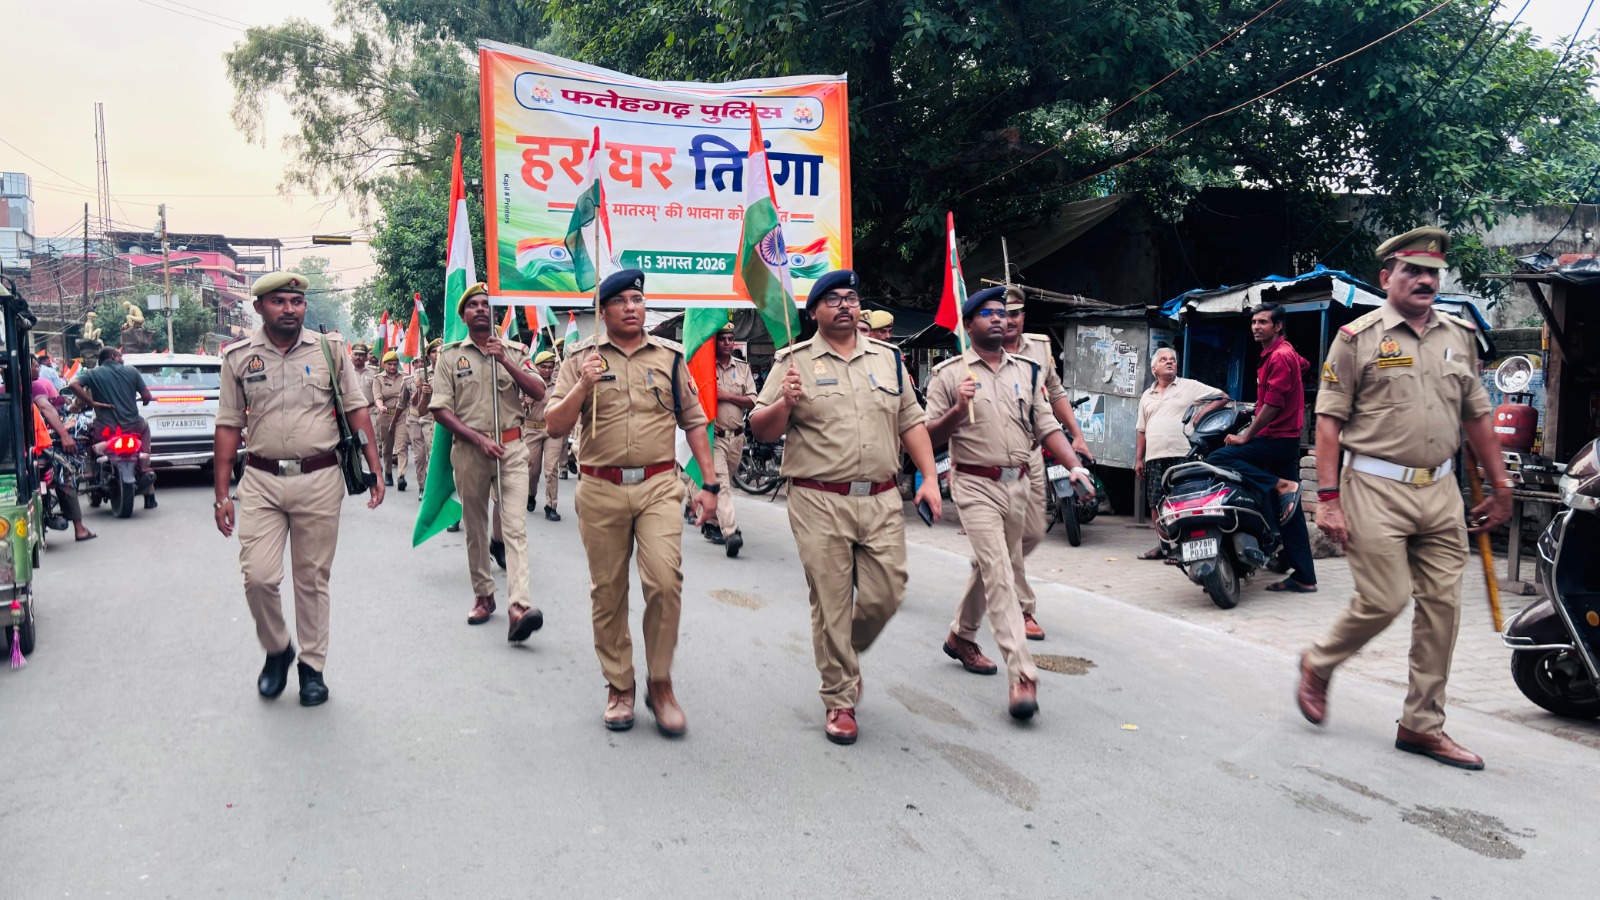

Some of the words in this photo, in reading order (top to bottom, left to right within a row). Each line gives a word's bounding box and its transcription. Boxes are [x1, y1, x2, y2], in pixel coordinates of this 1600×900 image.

[560, 89, 694, 119] फतेहगढ़
[700, 101, 783, 124] पुलिस
[516, 135, 589, 192] हर
[605, 142, 677, 190] घर
[688, 134, 823, 196] तिंगा
[502, 173, 510, 190] Kapil
[665, 202, 683, 218] की
[687, 206, 724, 220] भावना
[728, 205, 745, 221] को
[636, 255, 652, 269] 15
[655, 256, 693, 270] अगस्त
[695, 257, 727, 271] 2026
